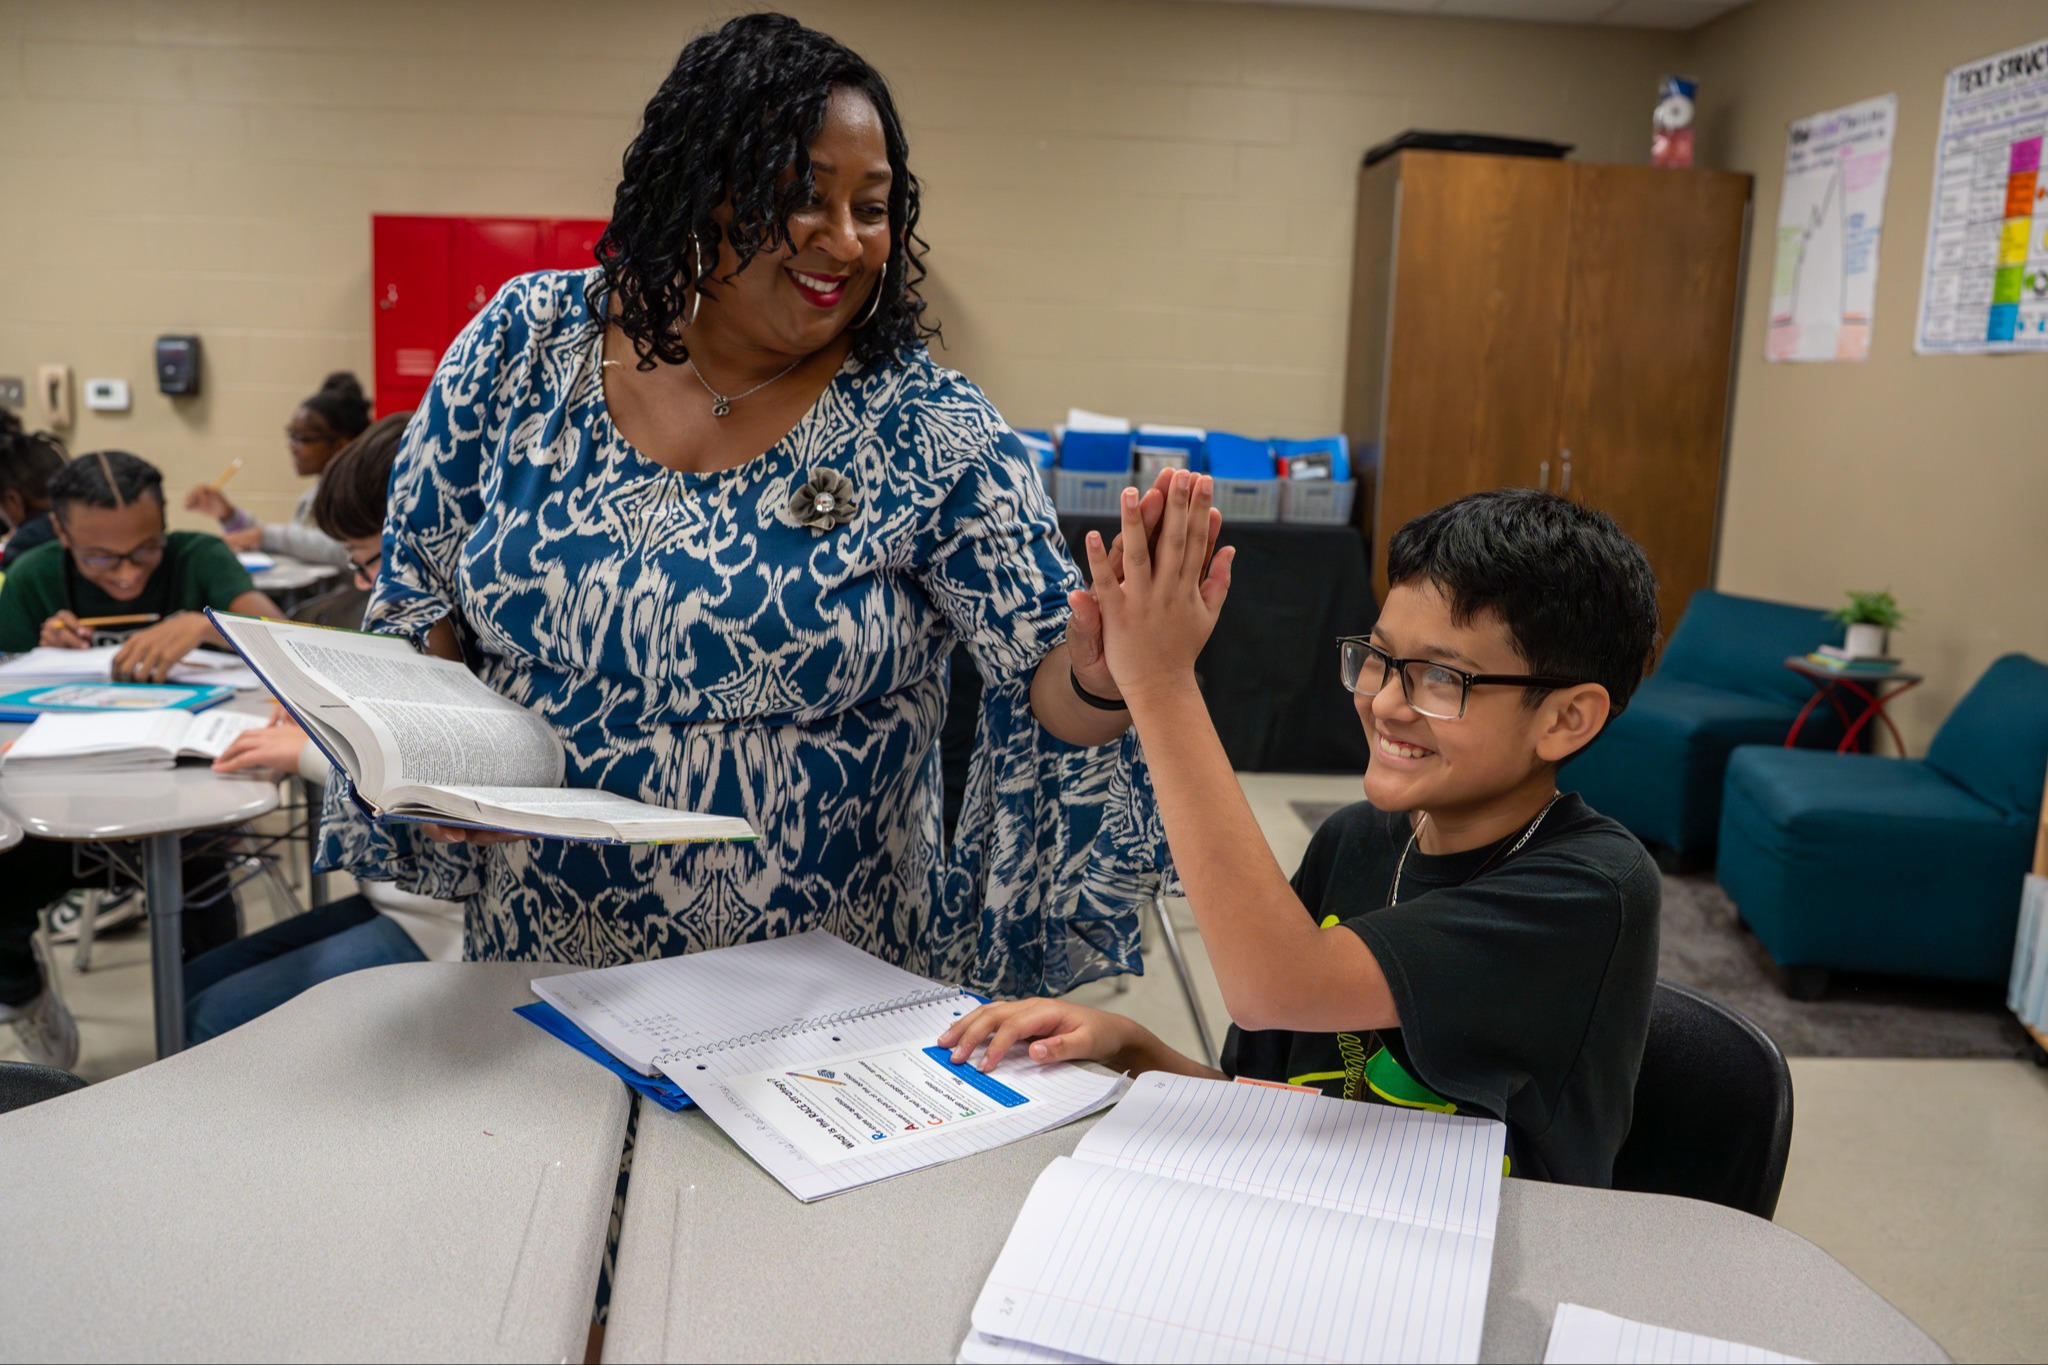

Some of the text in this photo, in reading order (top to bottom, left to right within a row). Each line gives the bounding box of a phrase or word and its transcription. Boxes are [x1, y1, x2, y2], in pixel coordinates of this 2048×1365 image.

[1958, 64, 1992, 94] TEXT
[767, 1078, 802, 1104] strategy?
[797, 1103, 818, 1118] RACE
[853, 1112, 863, 1120] the
[816, 1118, 830, 1128] the
[833, 1134, 854, 1149] What
